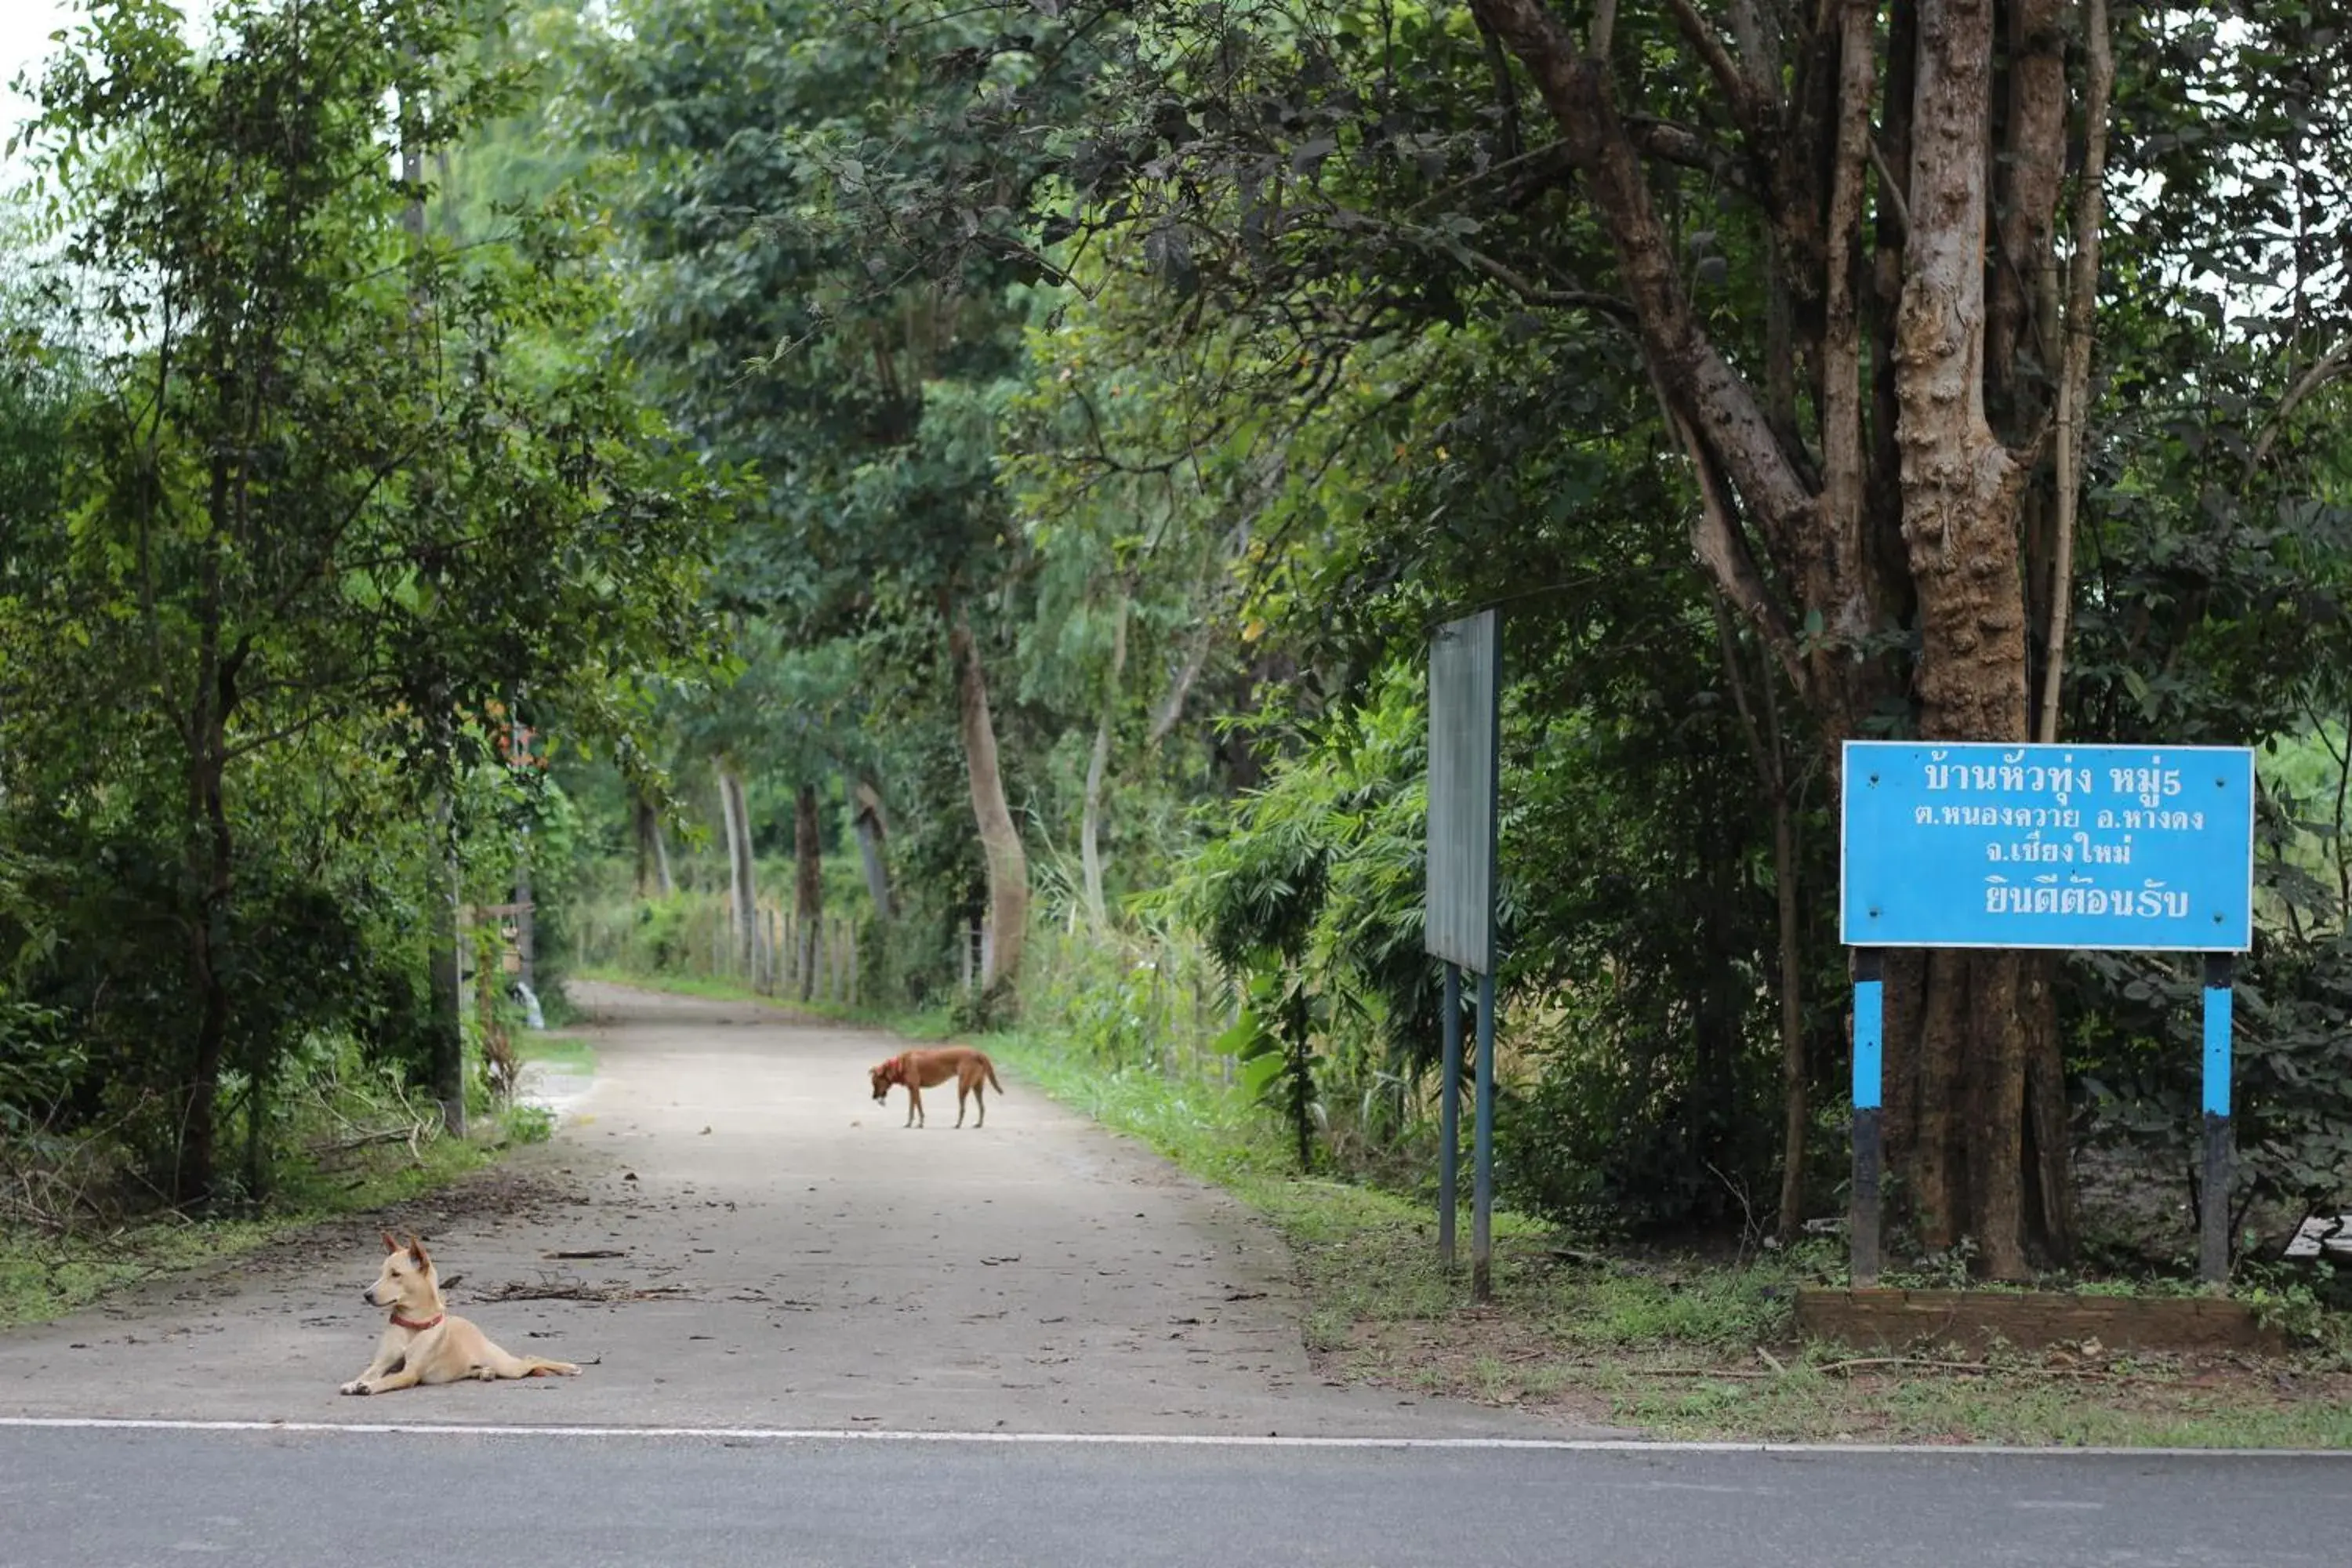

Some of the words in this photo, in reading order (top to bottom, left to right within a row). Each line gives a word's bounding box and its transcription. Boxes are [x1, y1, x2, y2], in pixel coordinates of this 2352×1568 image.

[1924, 750, 2092, 807] บ้านหัวทุ่ง
[2108, 755, 2182, 808] หมู่5
[1915, 805, 2080, 828] ต.หนองควาย
[2097, 809, 2205, 831] อ.หางดง
[1985, 830, 2132, 865] จ.เชียงใหม่
[1984, 873, 2189, 918] ยินดีต้อนรับ
